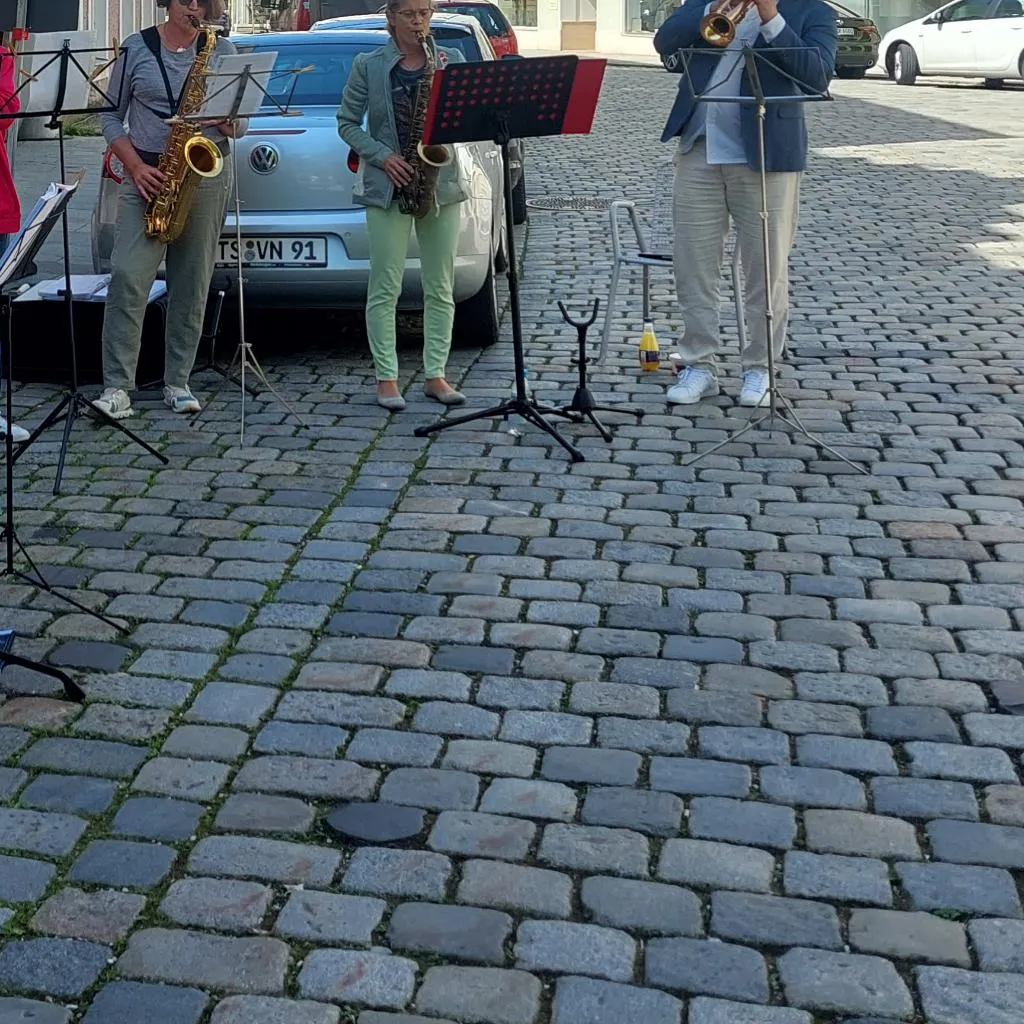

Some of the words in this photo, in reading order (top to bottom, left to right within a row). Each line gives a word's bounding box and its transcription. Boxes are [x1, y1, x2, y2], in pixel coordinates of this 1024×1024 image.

[218, 241, 240, 260] TS
[256, 241, 282, 260] VN
[291, 240, 317, 260] 91
